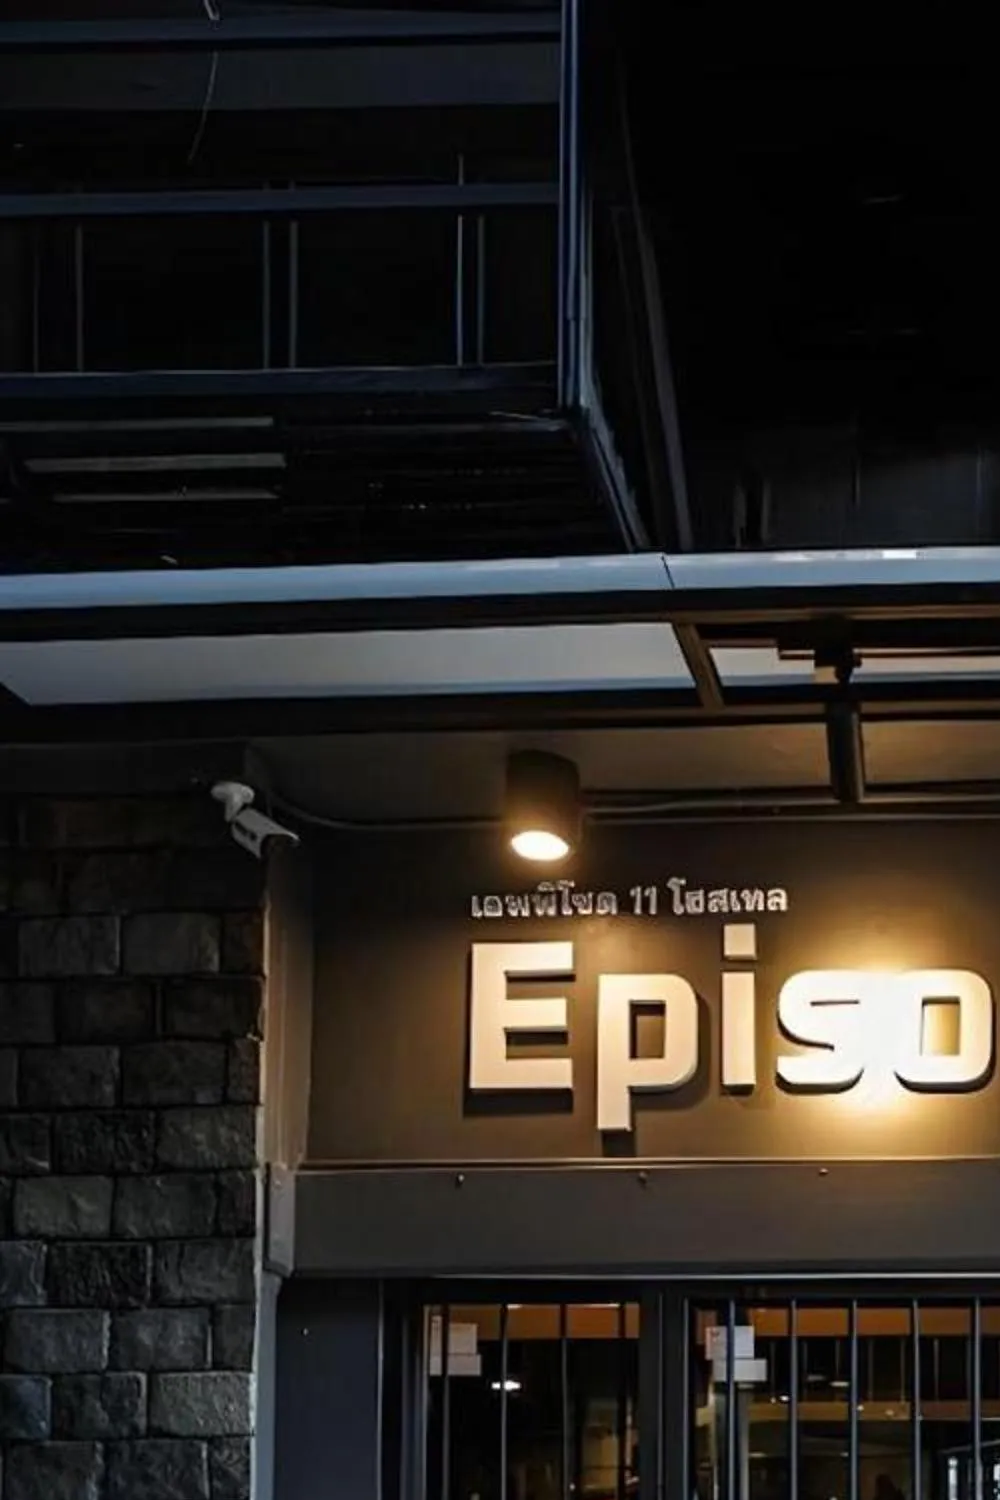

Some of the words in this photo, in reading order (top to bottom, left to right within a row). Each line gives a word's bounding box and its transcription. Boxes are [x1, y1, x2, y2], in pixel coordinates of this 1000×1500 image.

[629, 885, 658, 915] 11
[666, 876, 789, 915] โฮสเทล
